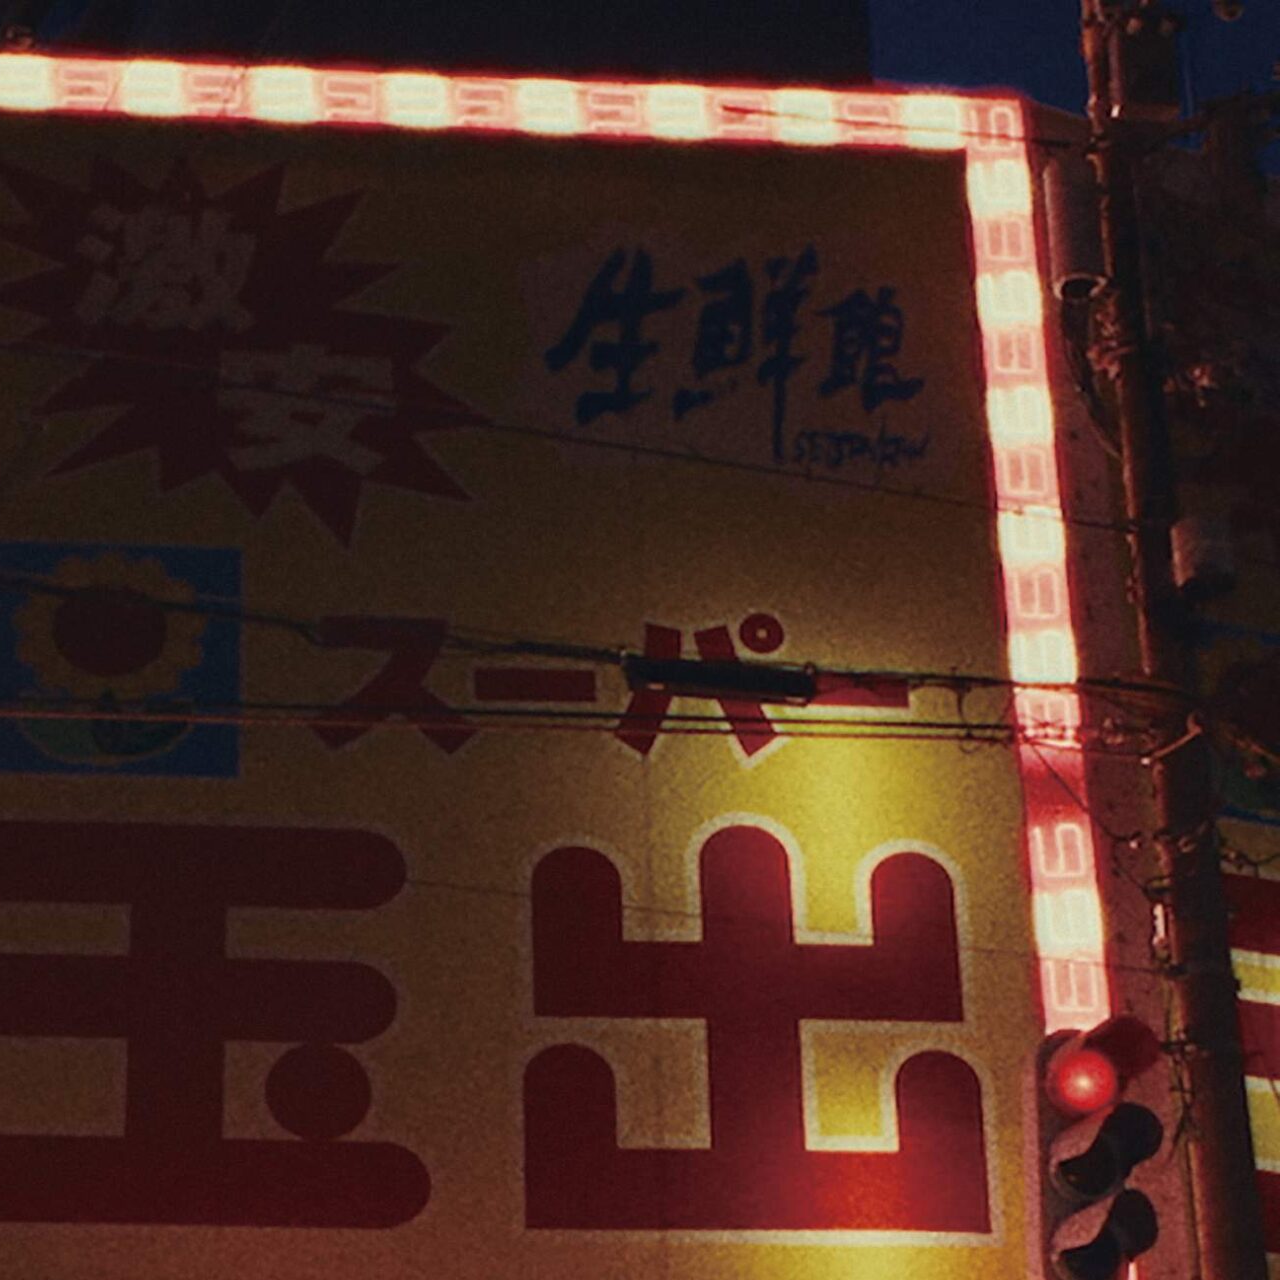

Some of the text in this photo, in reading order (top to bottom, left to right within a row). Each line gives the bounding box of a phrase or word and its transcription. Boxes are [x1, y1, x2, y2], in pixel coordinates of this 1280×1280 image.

[545, 243, 924, 462] 生鮮館
[308, 612, 910, 757] スーパー
